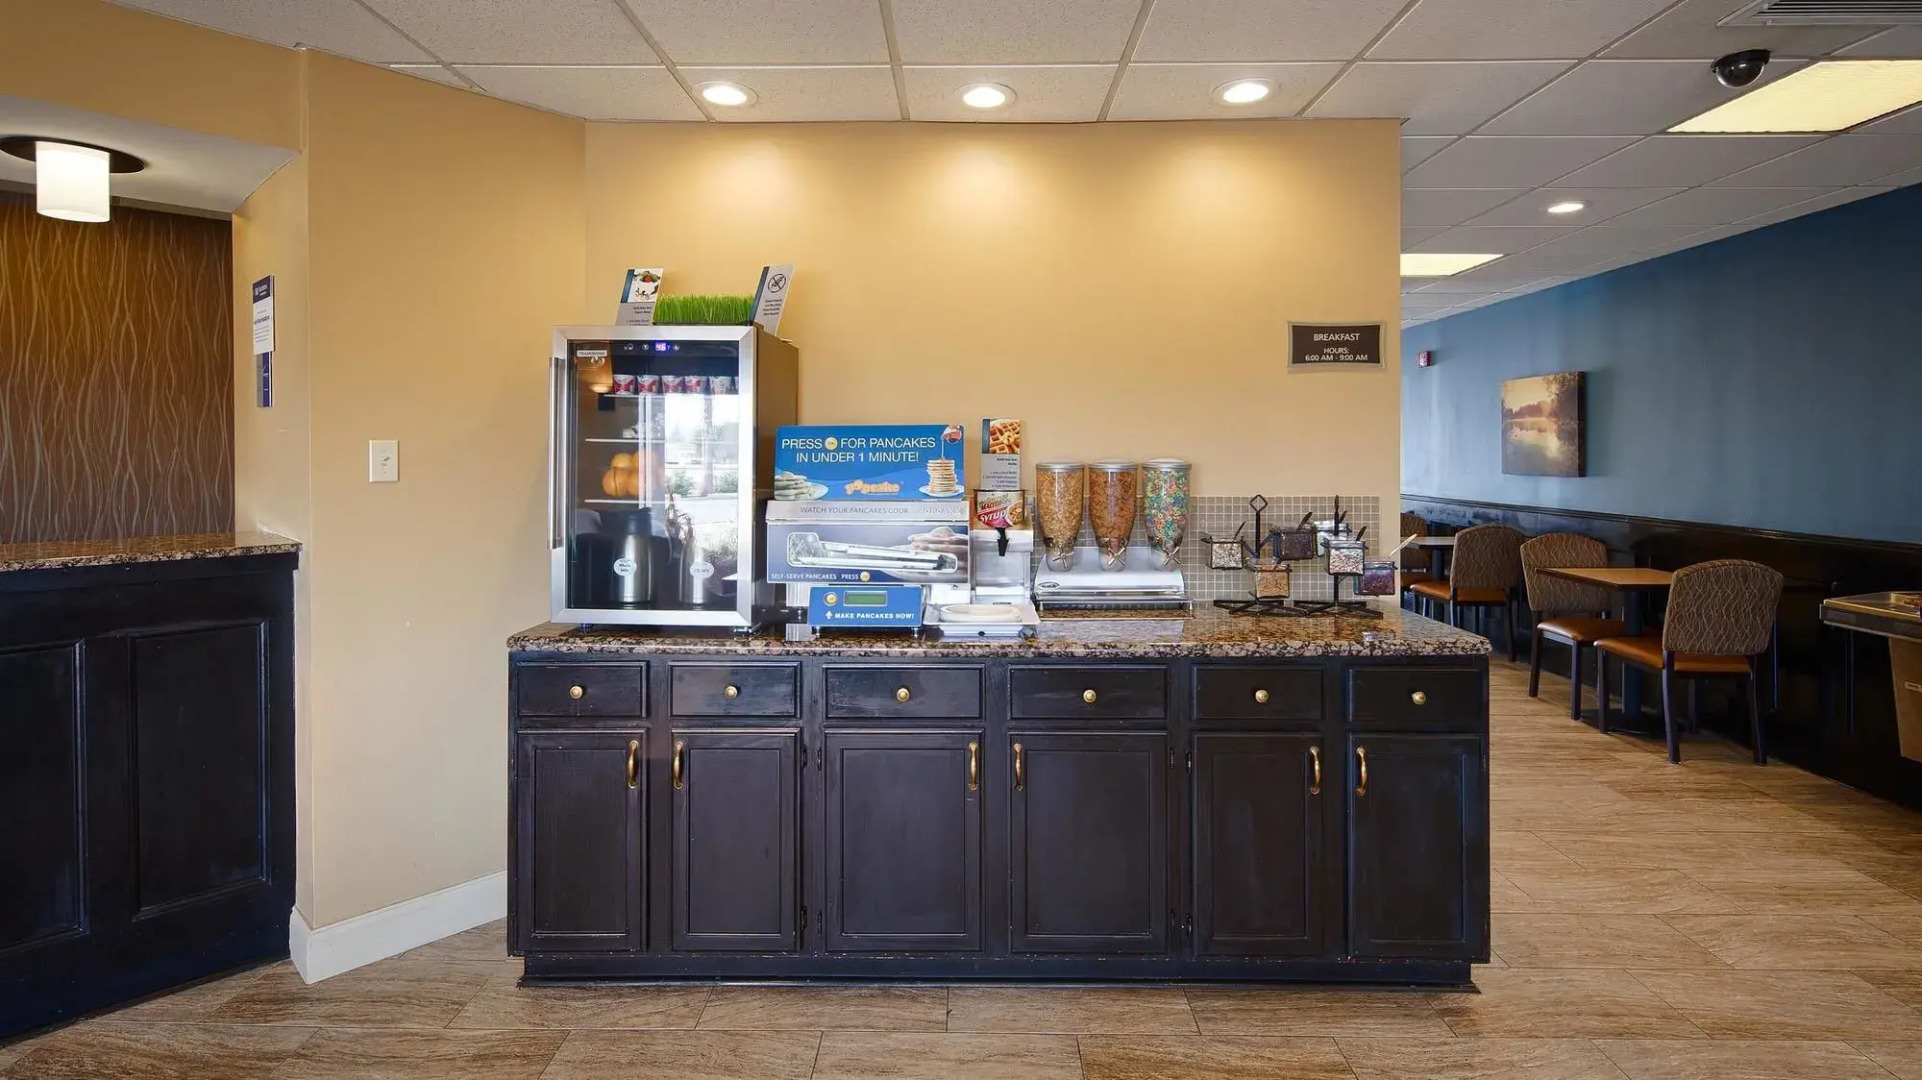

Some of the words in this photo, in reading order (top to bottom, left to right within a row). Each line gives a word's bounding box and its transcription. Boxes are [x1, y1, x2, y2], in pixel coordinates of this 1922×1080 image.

[1313, 333, 1360, 341] BREAKFAST
[782, 438, 822, 449] PRESS
[840, 438, 866, 449] FOR
[869, 437, 936, 448] PANCAKES
[796, 452, 808, 463] IN
[811, 452, 855, 463] UNDER
[858, 452, 864, 462] 1
[868, 451, 919, 462] MINUTE!
[895, 612, 915, 620] NOW!
